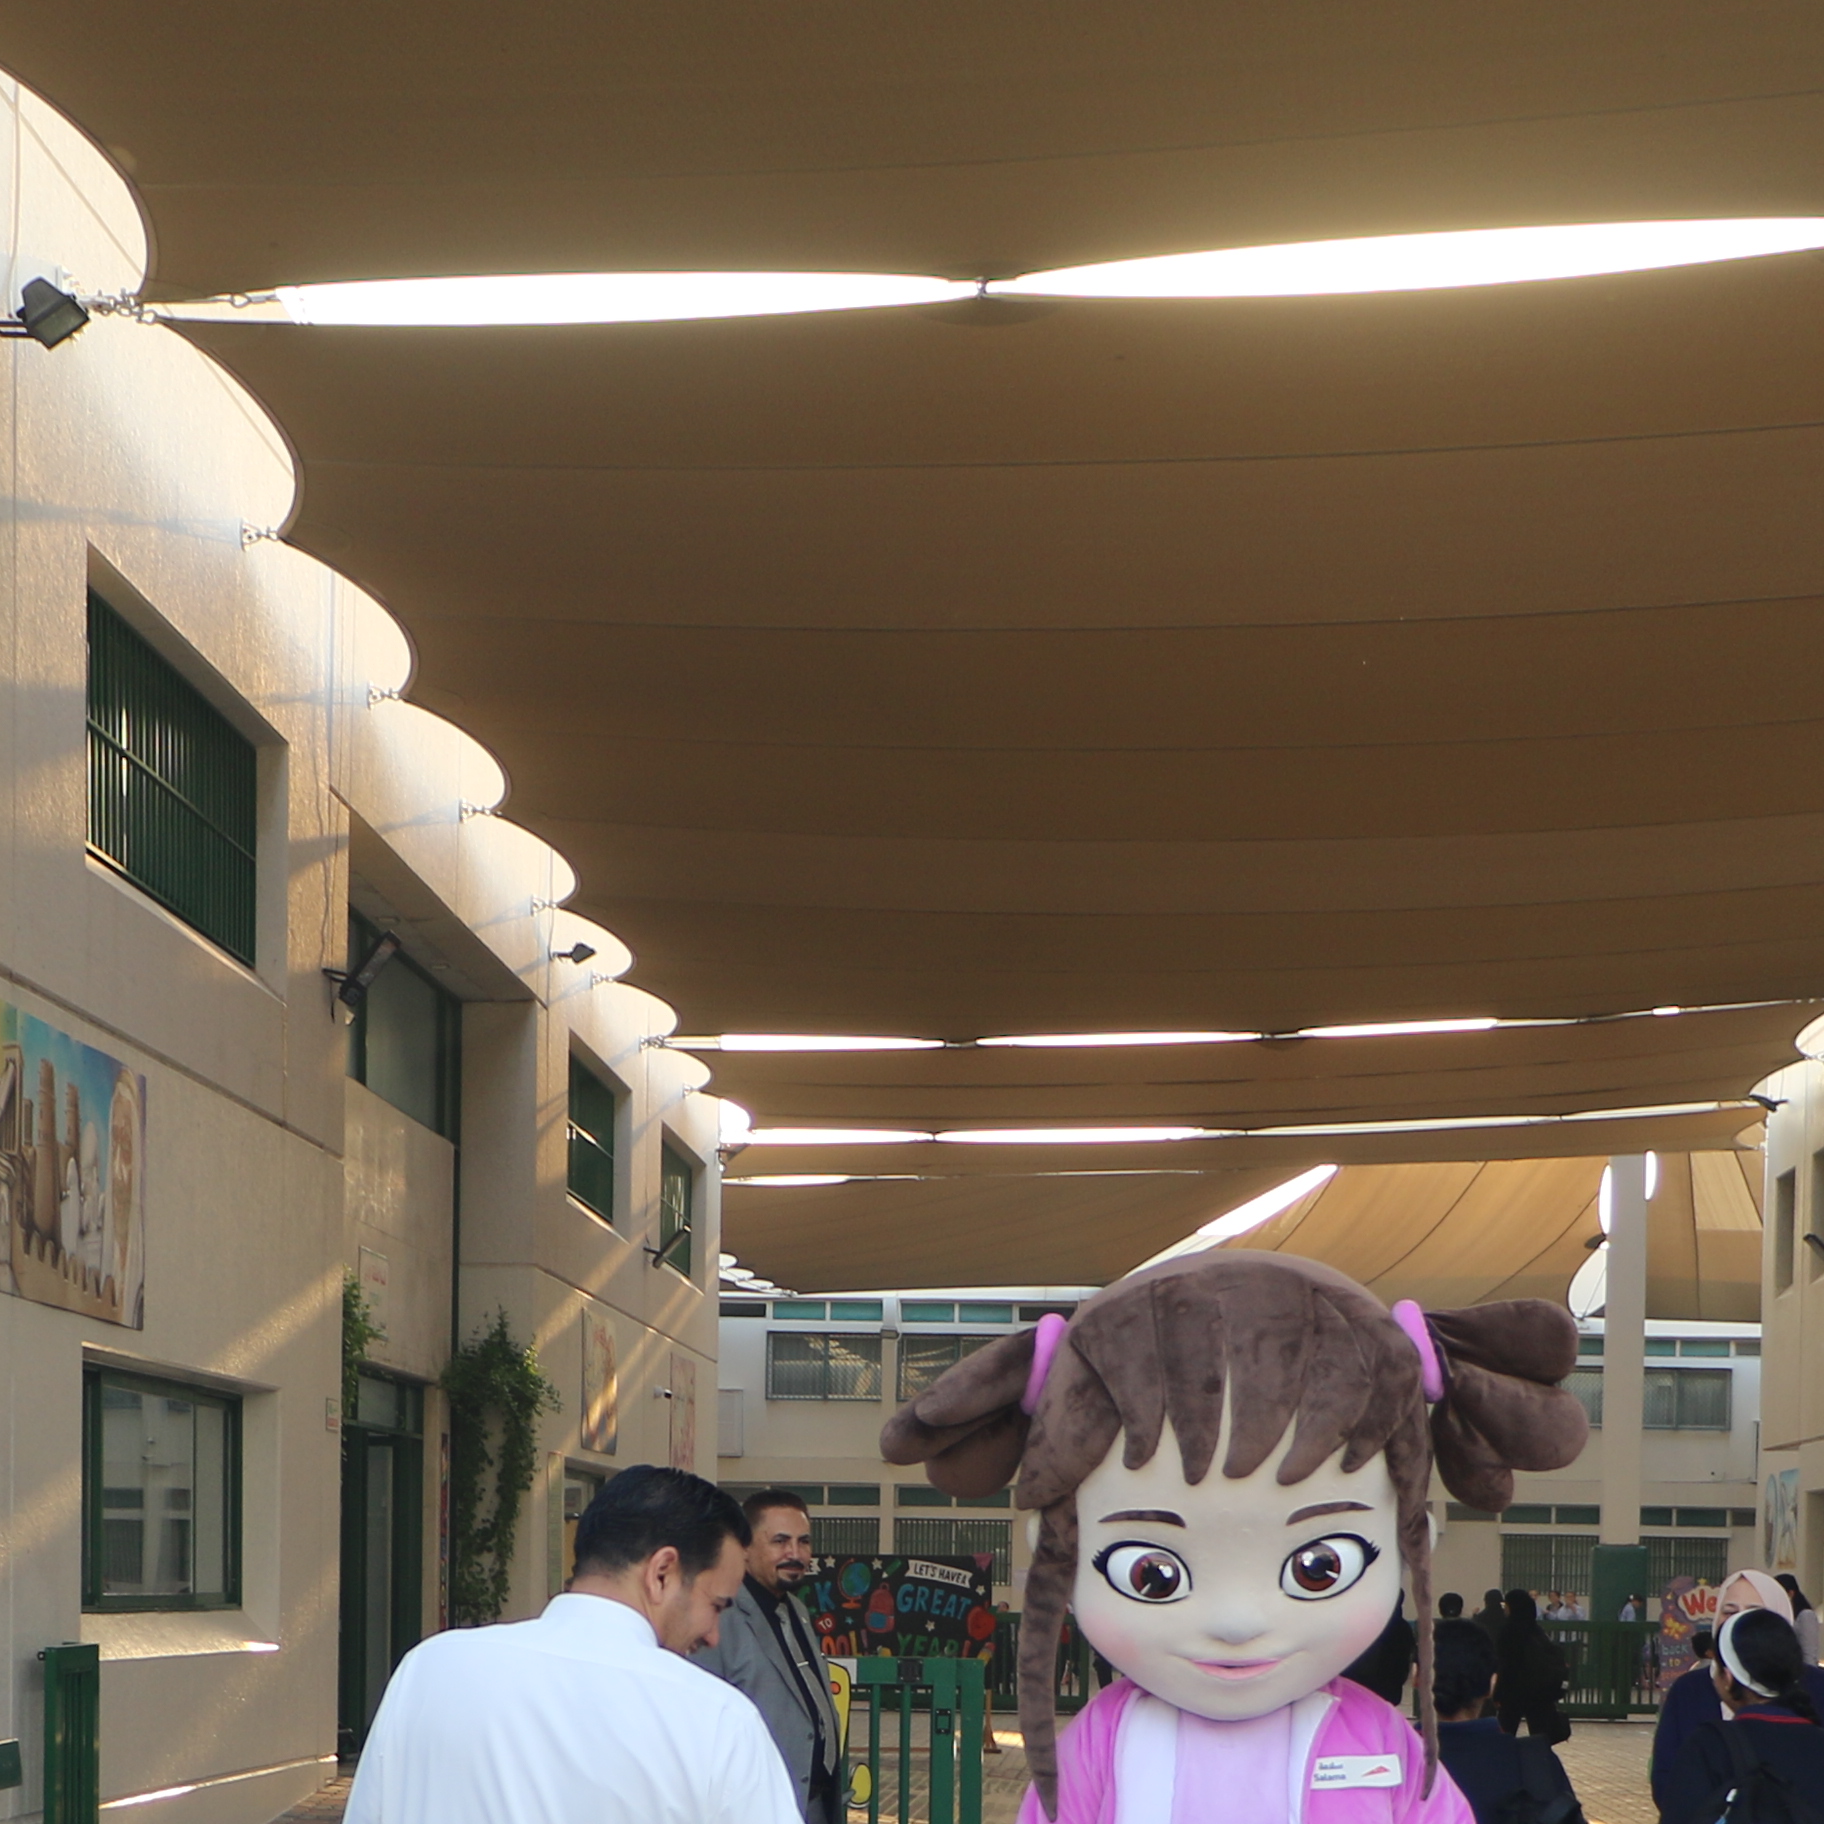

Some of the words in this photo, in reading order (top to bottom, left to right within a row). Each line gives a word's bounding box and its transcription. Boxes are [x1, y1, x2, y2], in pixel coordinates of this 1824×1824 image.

[913, 1563, 936, 1578] LET'S
[938, 1568, 961, 1584] HAVE
[895, 1582, 973, 1621] GREAT
[818, 1617, 834, 1631] TO
